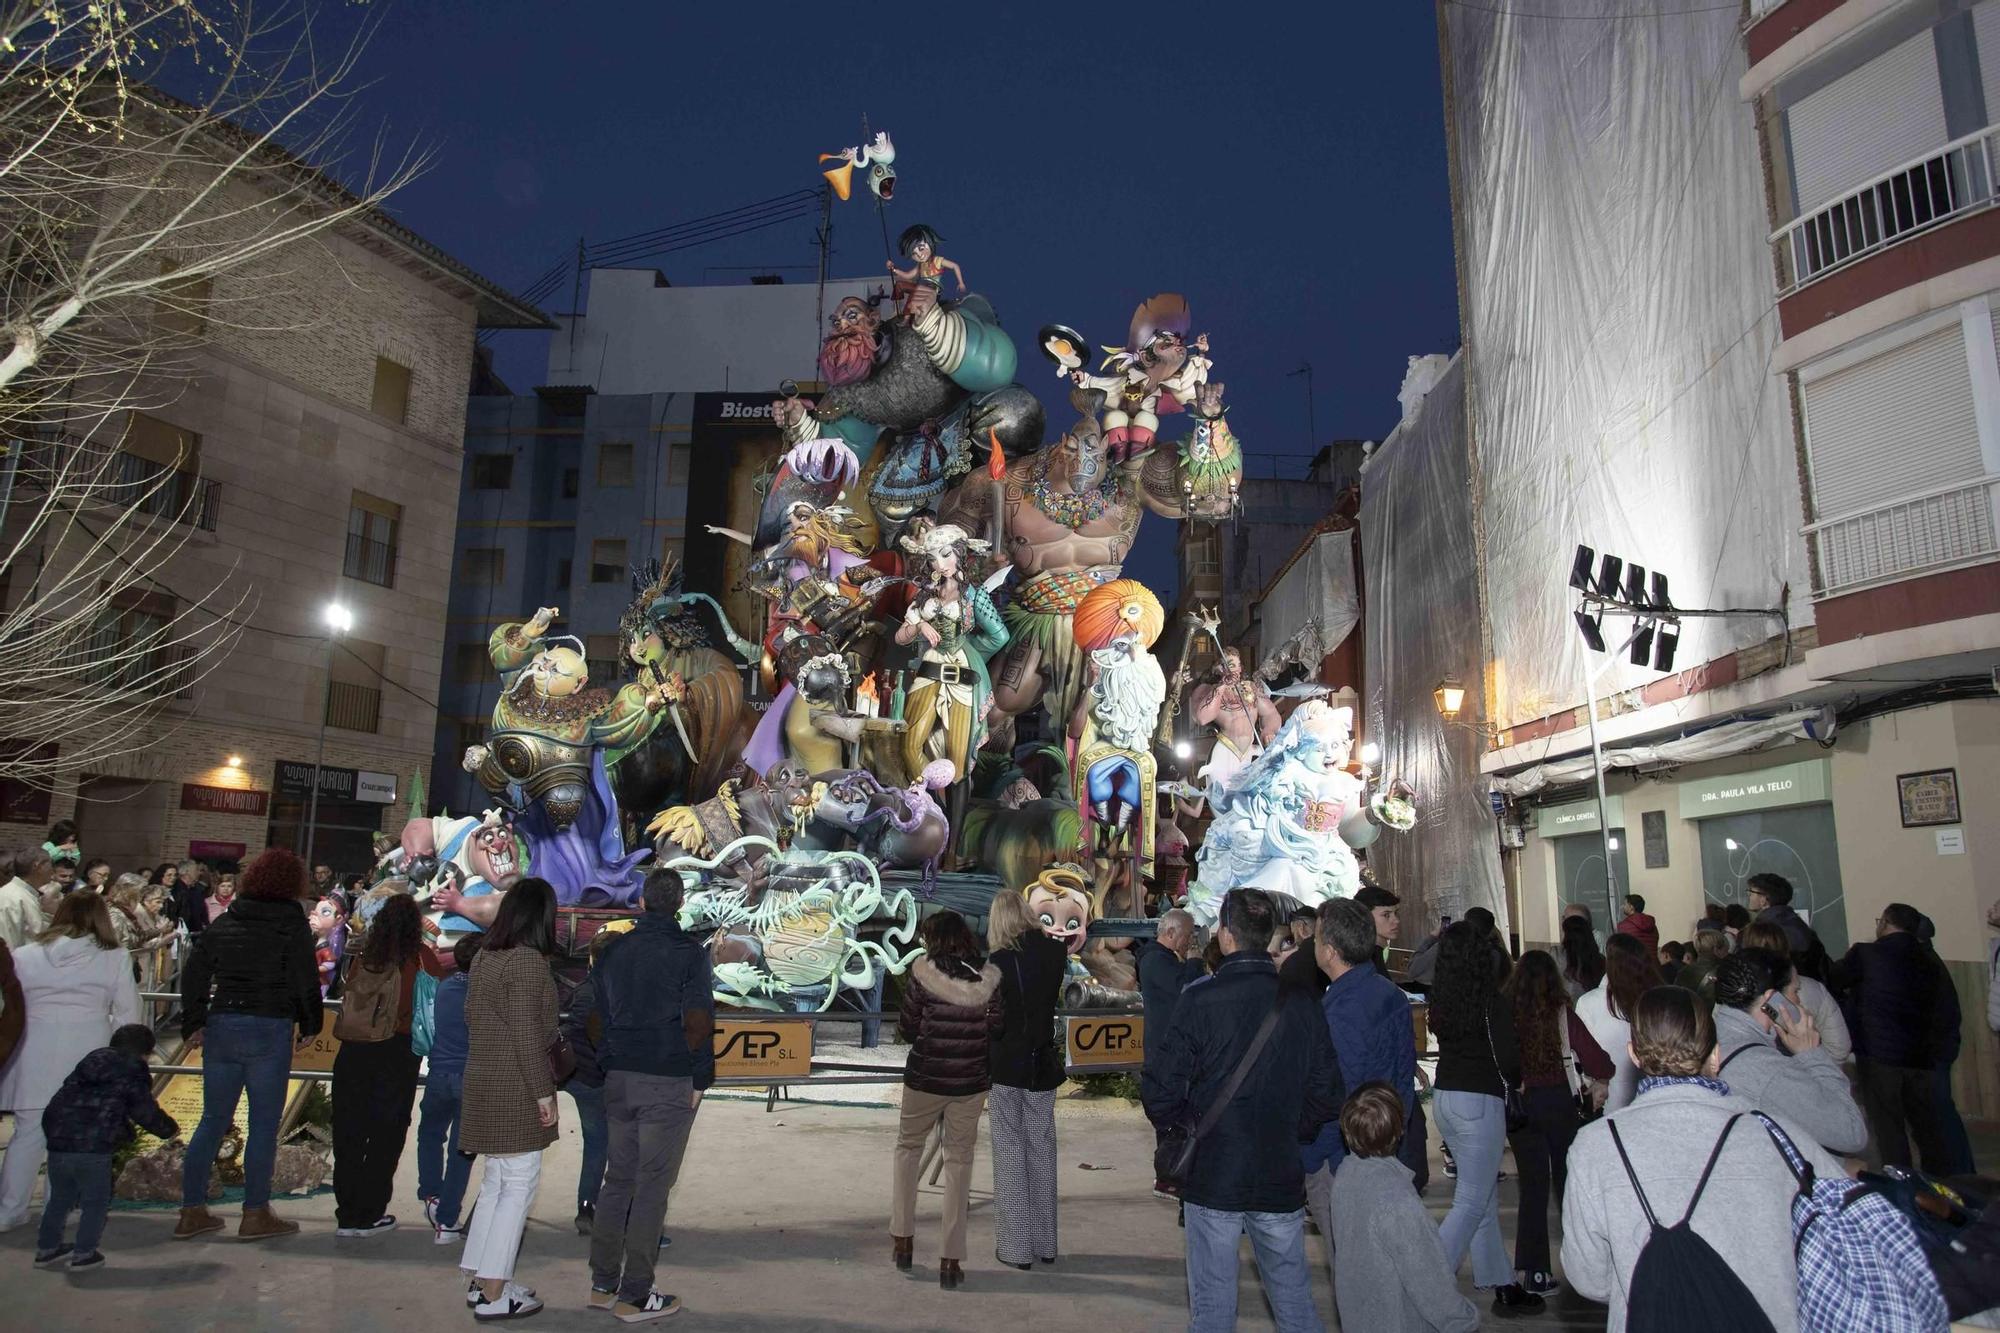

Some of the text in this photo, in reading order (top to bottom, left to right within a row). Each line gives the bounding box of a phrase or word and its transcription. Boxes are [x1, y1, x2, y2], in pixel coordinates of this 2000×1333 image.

[720, 402, 774, 418] Biost
[1720, 787, 1745, 799] PAULA
[1747, 784, 1765, 795] VILA
[1767, 780, 1793, 792] TELLO
[1556, 811, 1596, 824] CLÍNICA DENTAL
[314, 1039, 335, 1052] S.L.
[778, 1048, 798, 1060] S.L.
